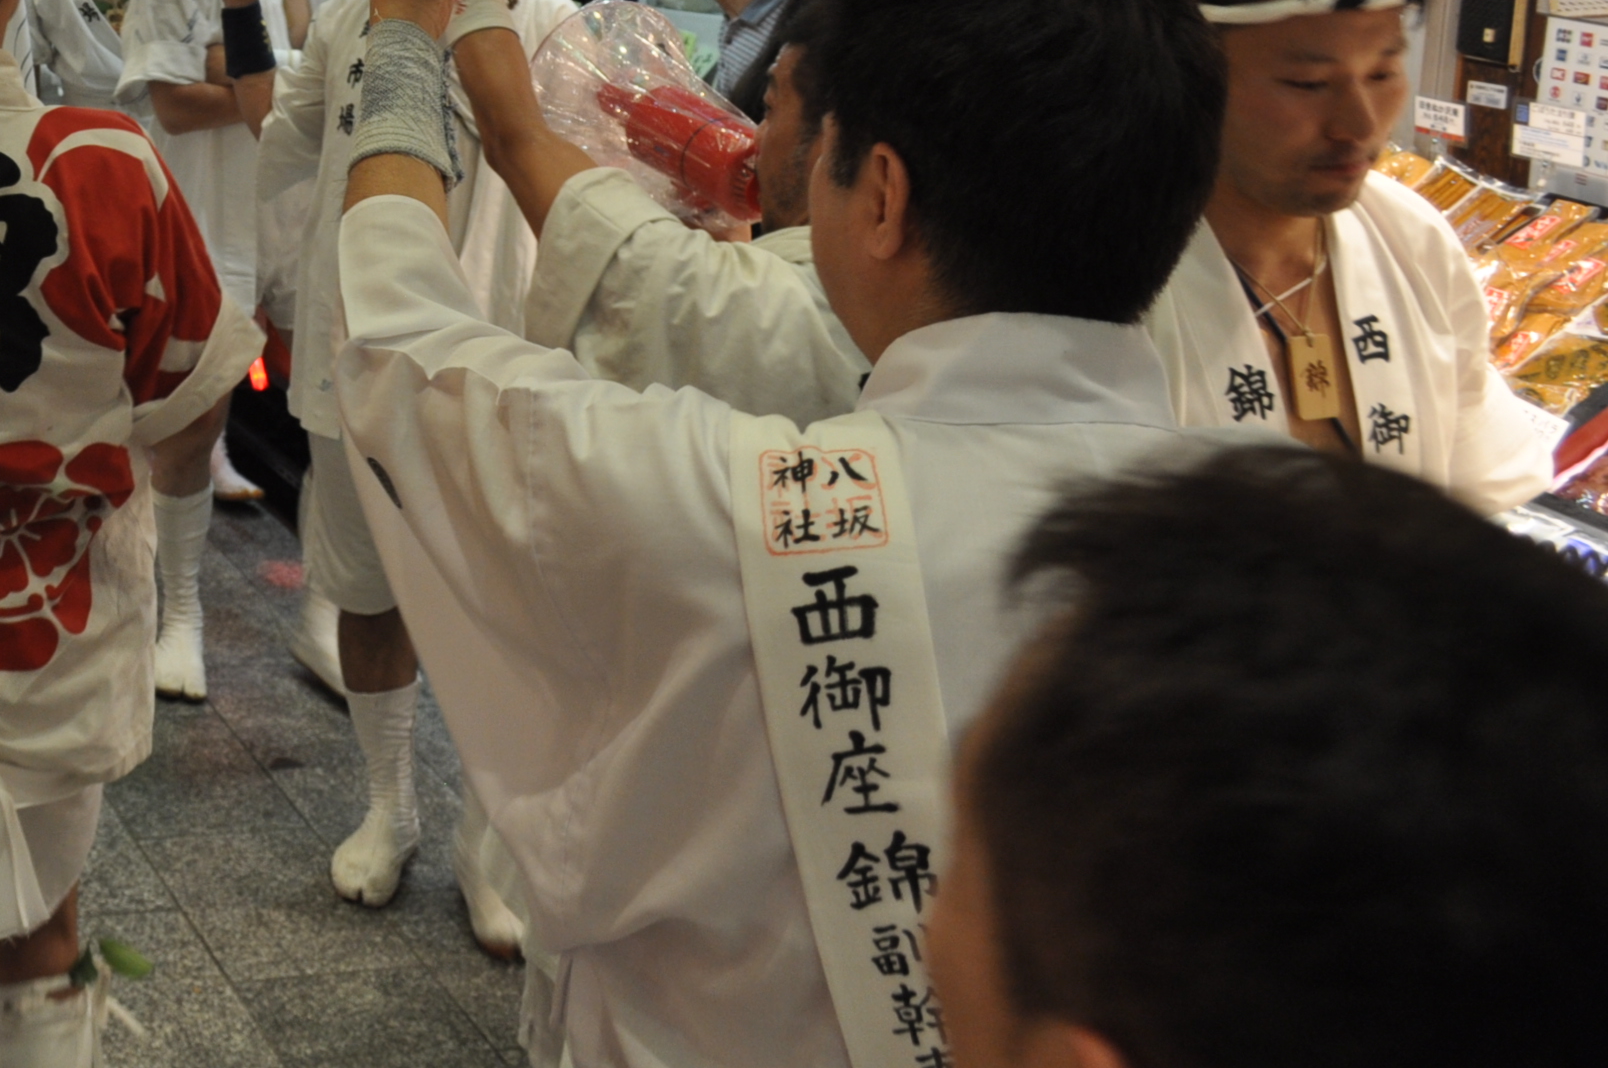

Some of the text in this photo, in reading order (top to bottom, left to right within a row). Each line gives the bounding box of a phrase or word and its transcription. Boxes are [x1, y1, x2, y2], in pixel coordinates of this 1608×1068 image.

[1224, 363, 1276, 422] 錦
[1351, 313, 1412, 456] 西御
[772, 450, 822, 551] 神社
[827, 455, 882, 539] 八坂
